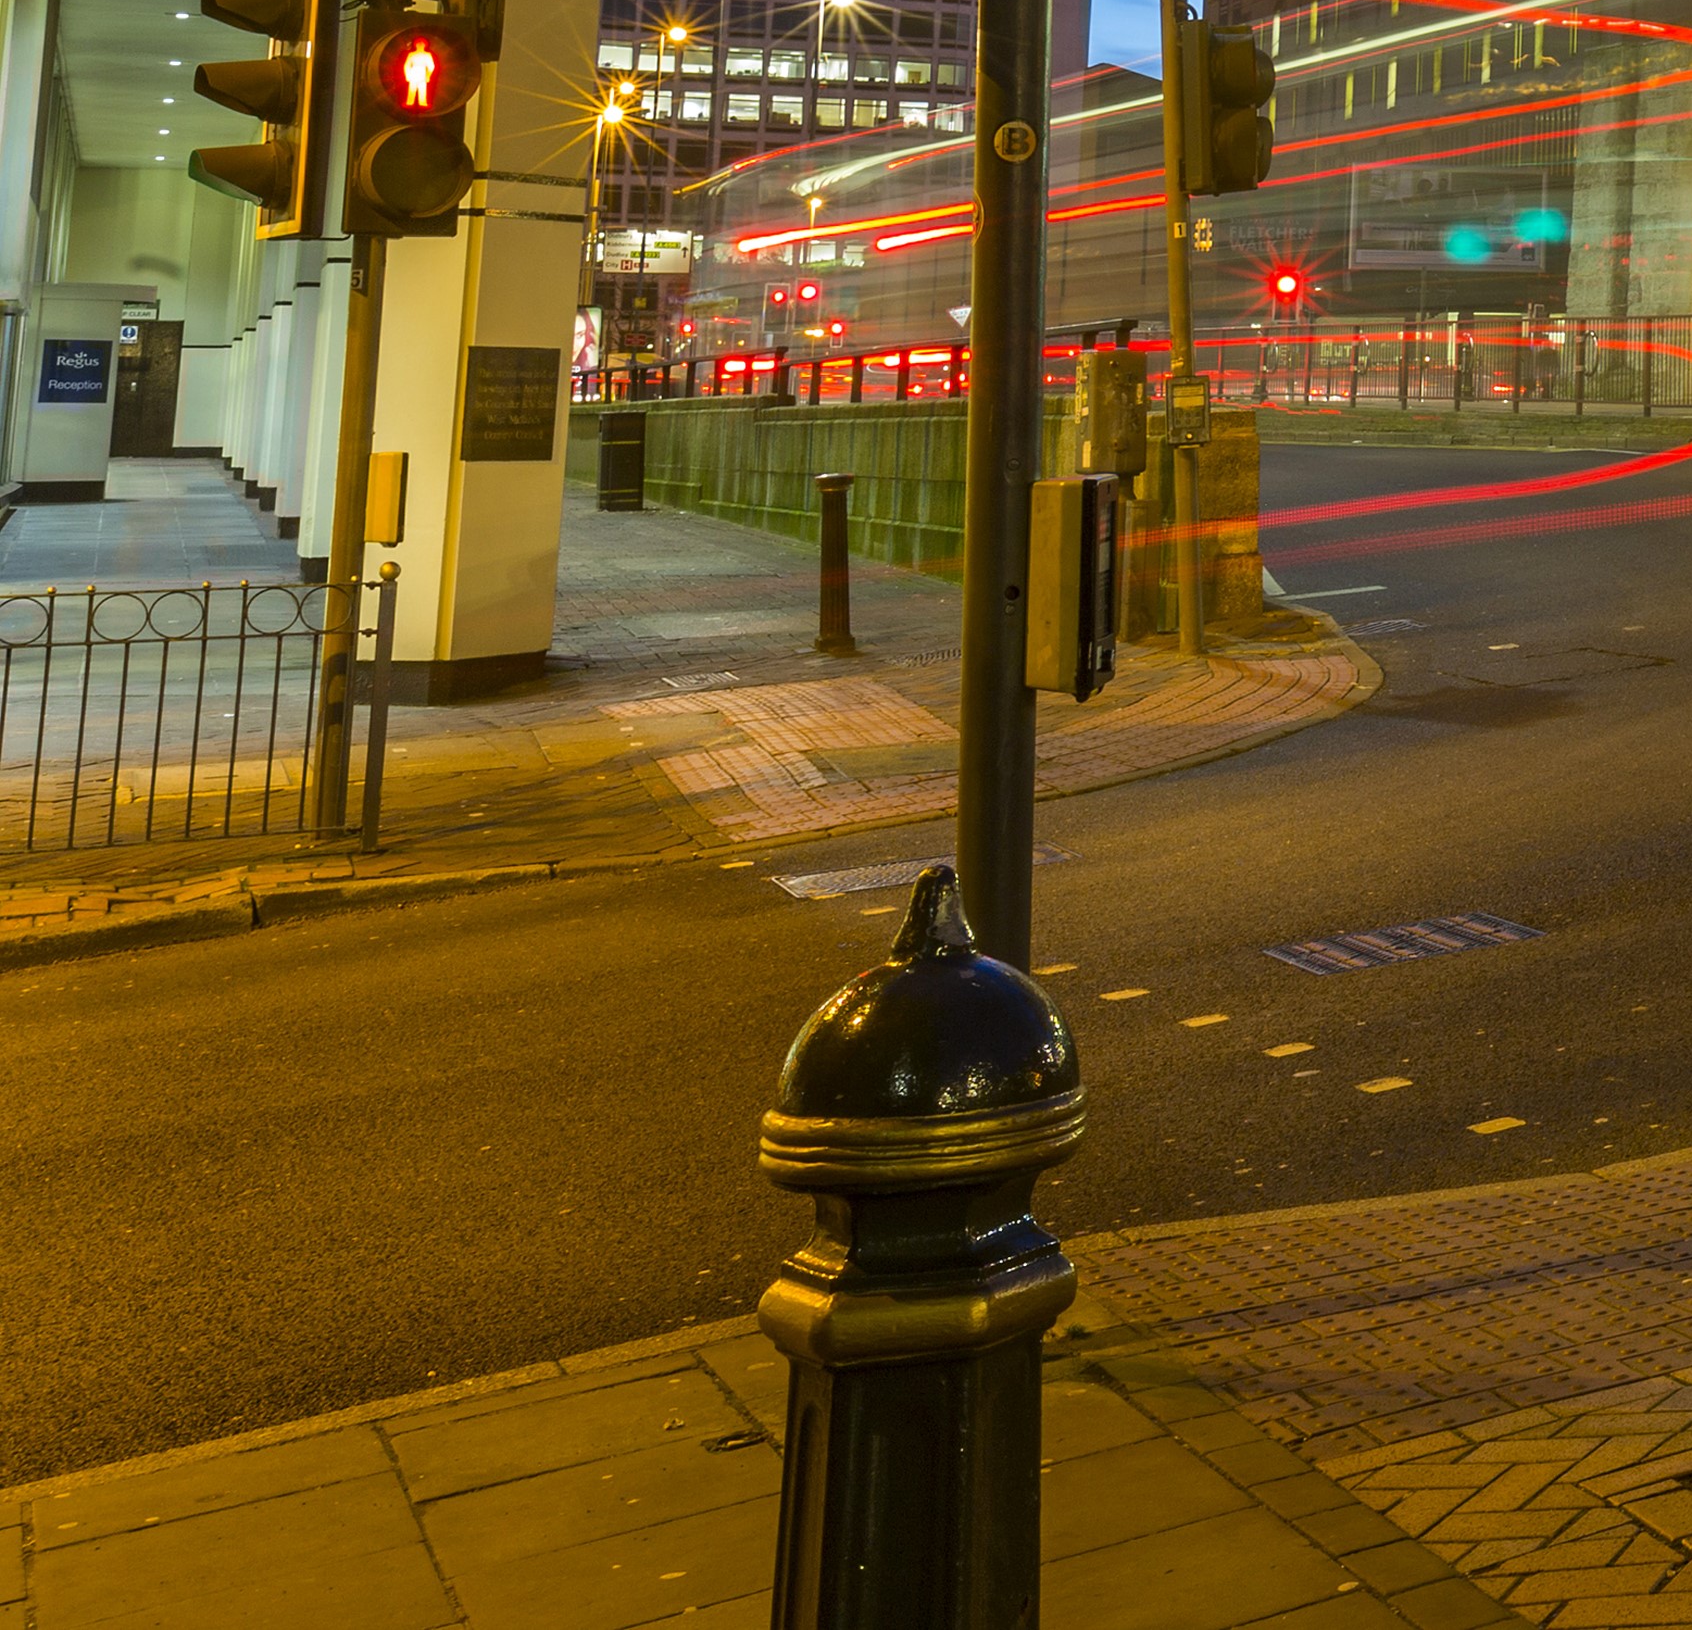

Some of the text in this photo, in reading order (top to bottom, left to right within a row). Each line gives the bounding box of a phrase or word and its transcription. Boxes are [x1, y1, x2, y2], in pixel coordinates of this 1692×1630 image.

[1002, 127, 1030, 155] B
[1177, 224, 1183, 236] 1
[1229, 226, 1315, 241] FLETCHERS
[1229, 239, 1277, 252] WALK
[351, 271, 361, 288] 5
[56, 354, 100, 369] Regus
[48, 379, 102, 391] Reception
